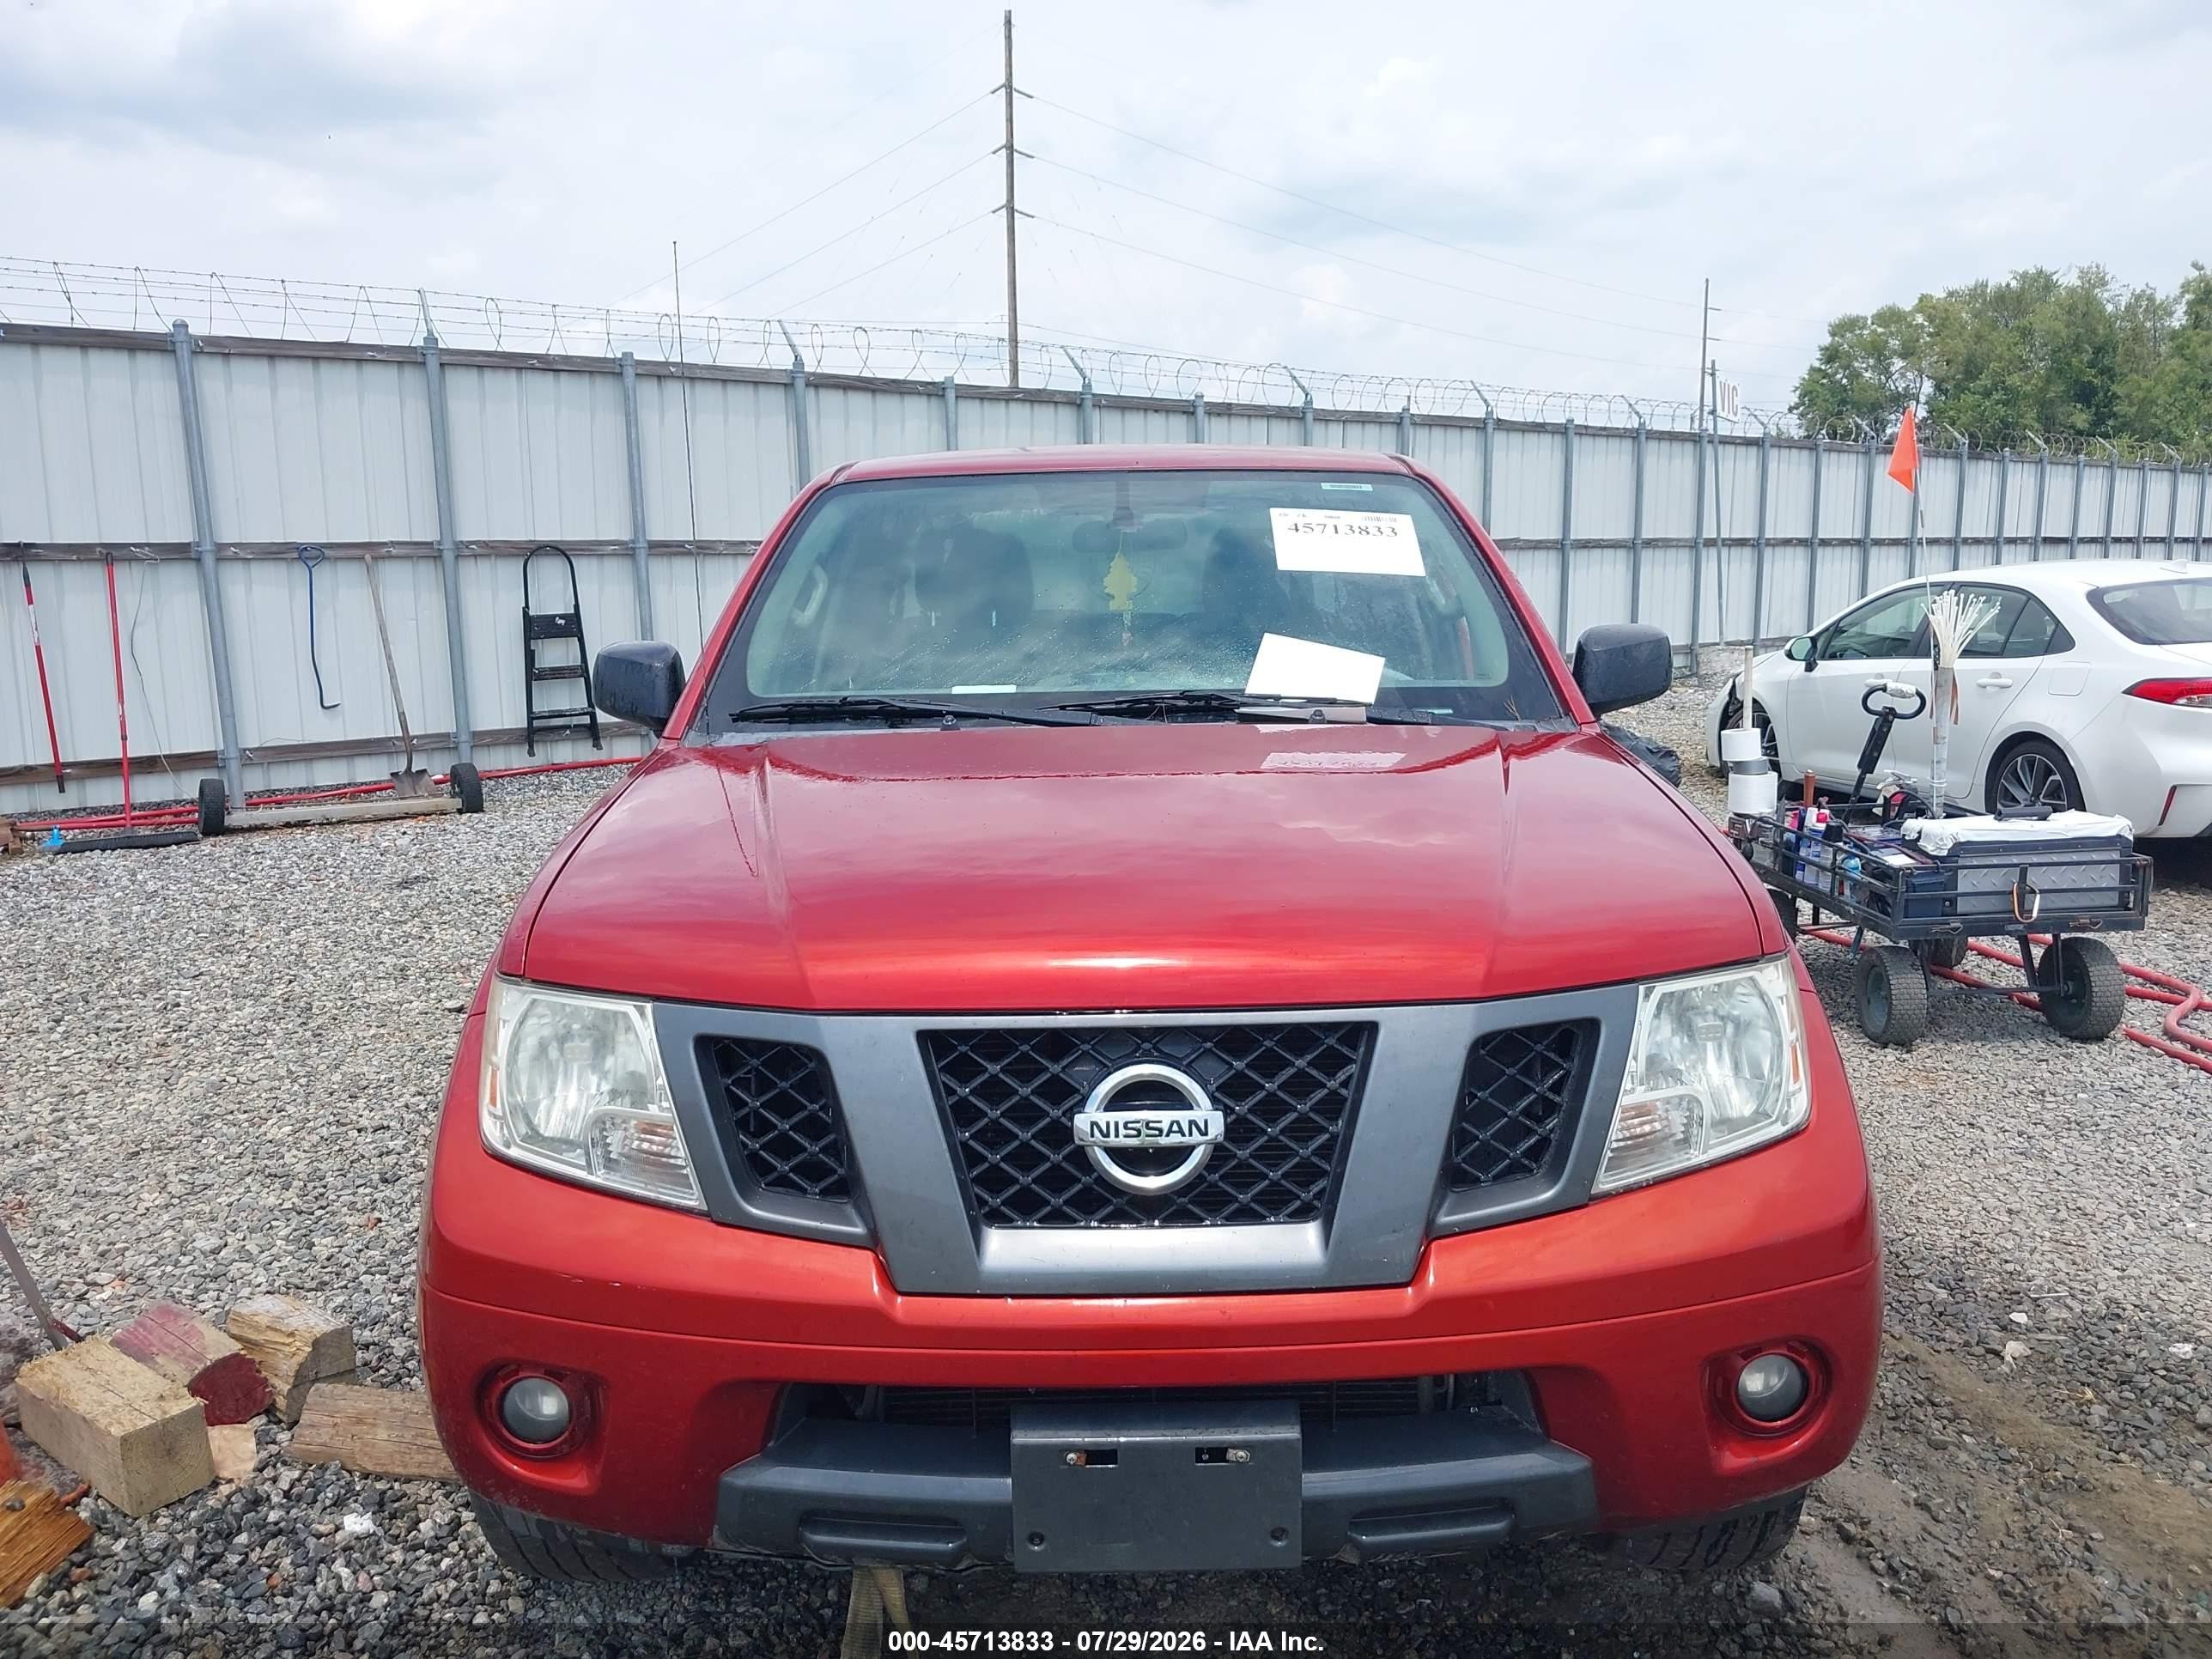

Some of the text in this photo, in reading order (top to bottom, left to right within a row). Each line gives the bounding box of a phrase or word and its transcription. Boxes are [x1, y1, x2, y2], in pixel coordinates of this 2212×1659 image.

[1718, 380, 1738, 417] VIC
[1287, 522, 1399, 538] 45713833
[1089, 1118, 1209, 1139] NISSAN
